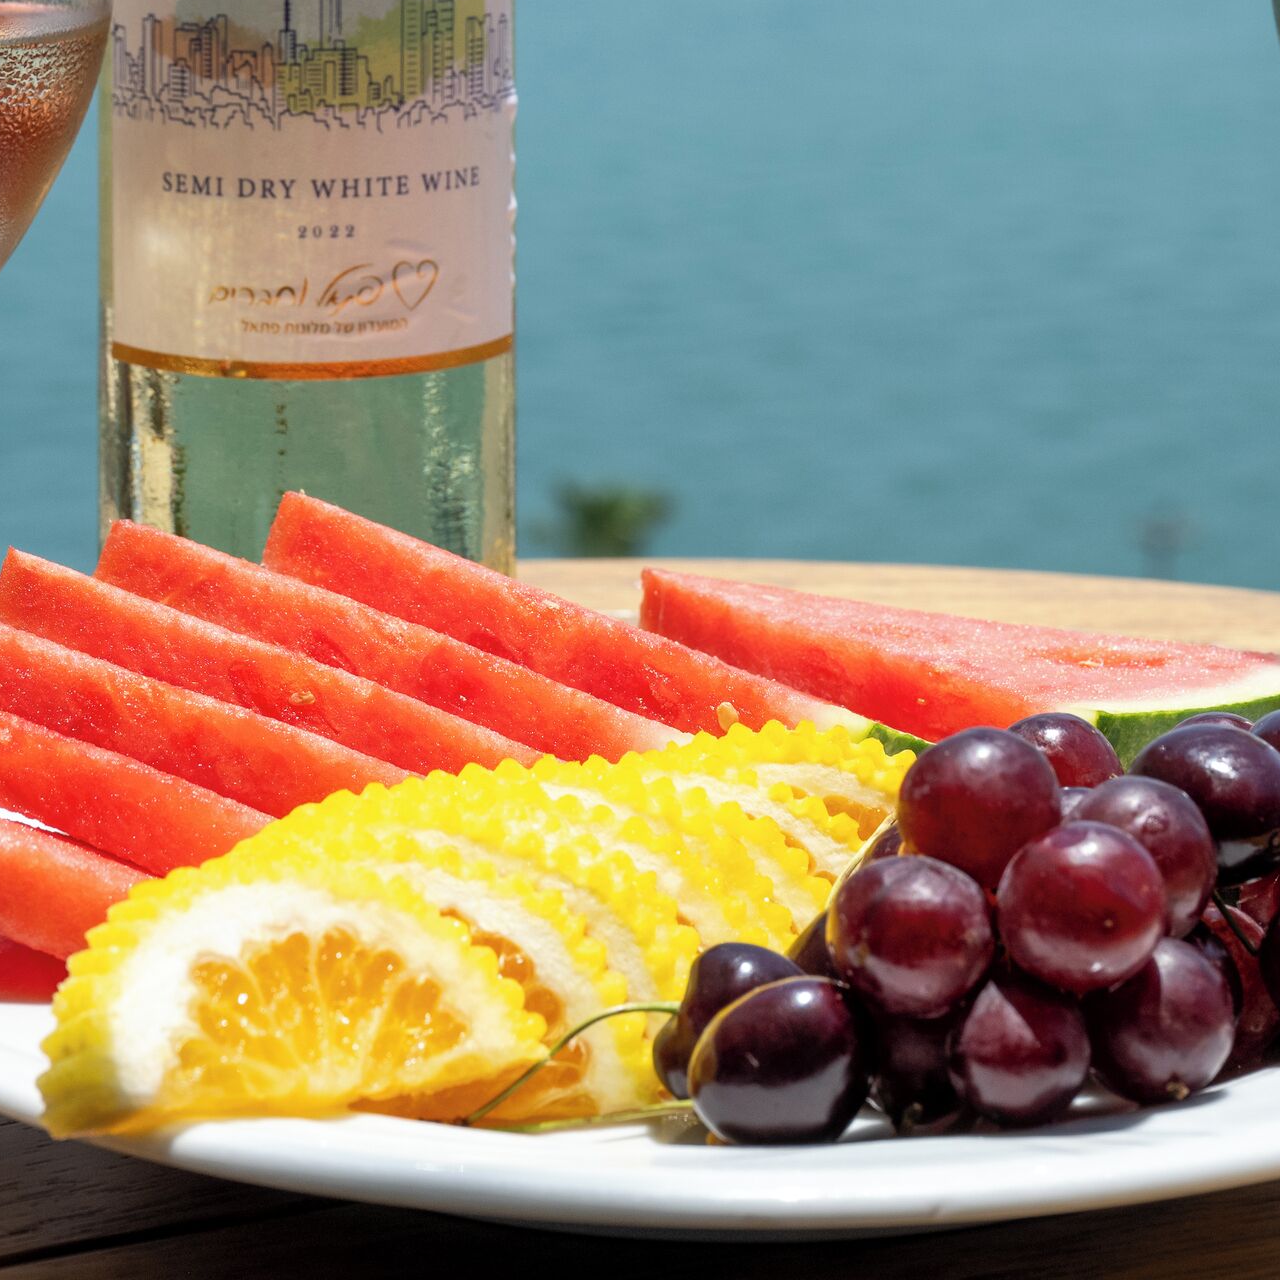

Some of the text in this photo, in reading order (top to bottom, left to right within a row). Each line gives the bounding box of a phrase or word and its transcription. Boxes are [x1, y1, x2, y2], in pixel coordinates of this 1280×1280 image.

[162, 166, 480, 199] SEMI DRY WHITE WINE
[297, 224, 356, 239] 2022
[240, 317, 409, 335] המועדון של מלונות פתאל
